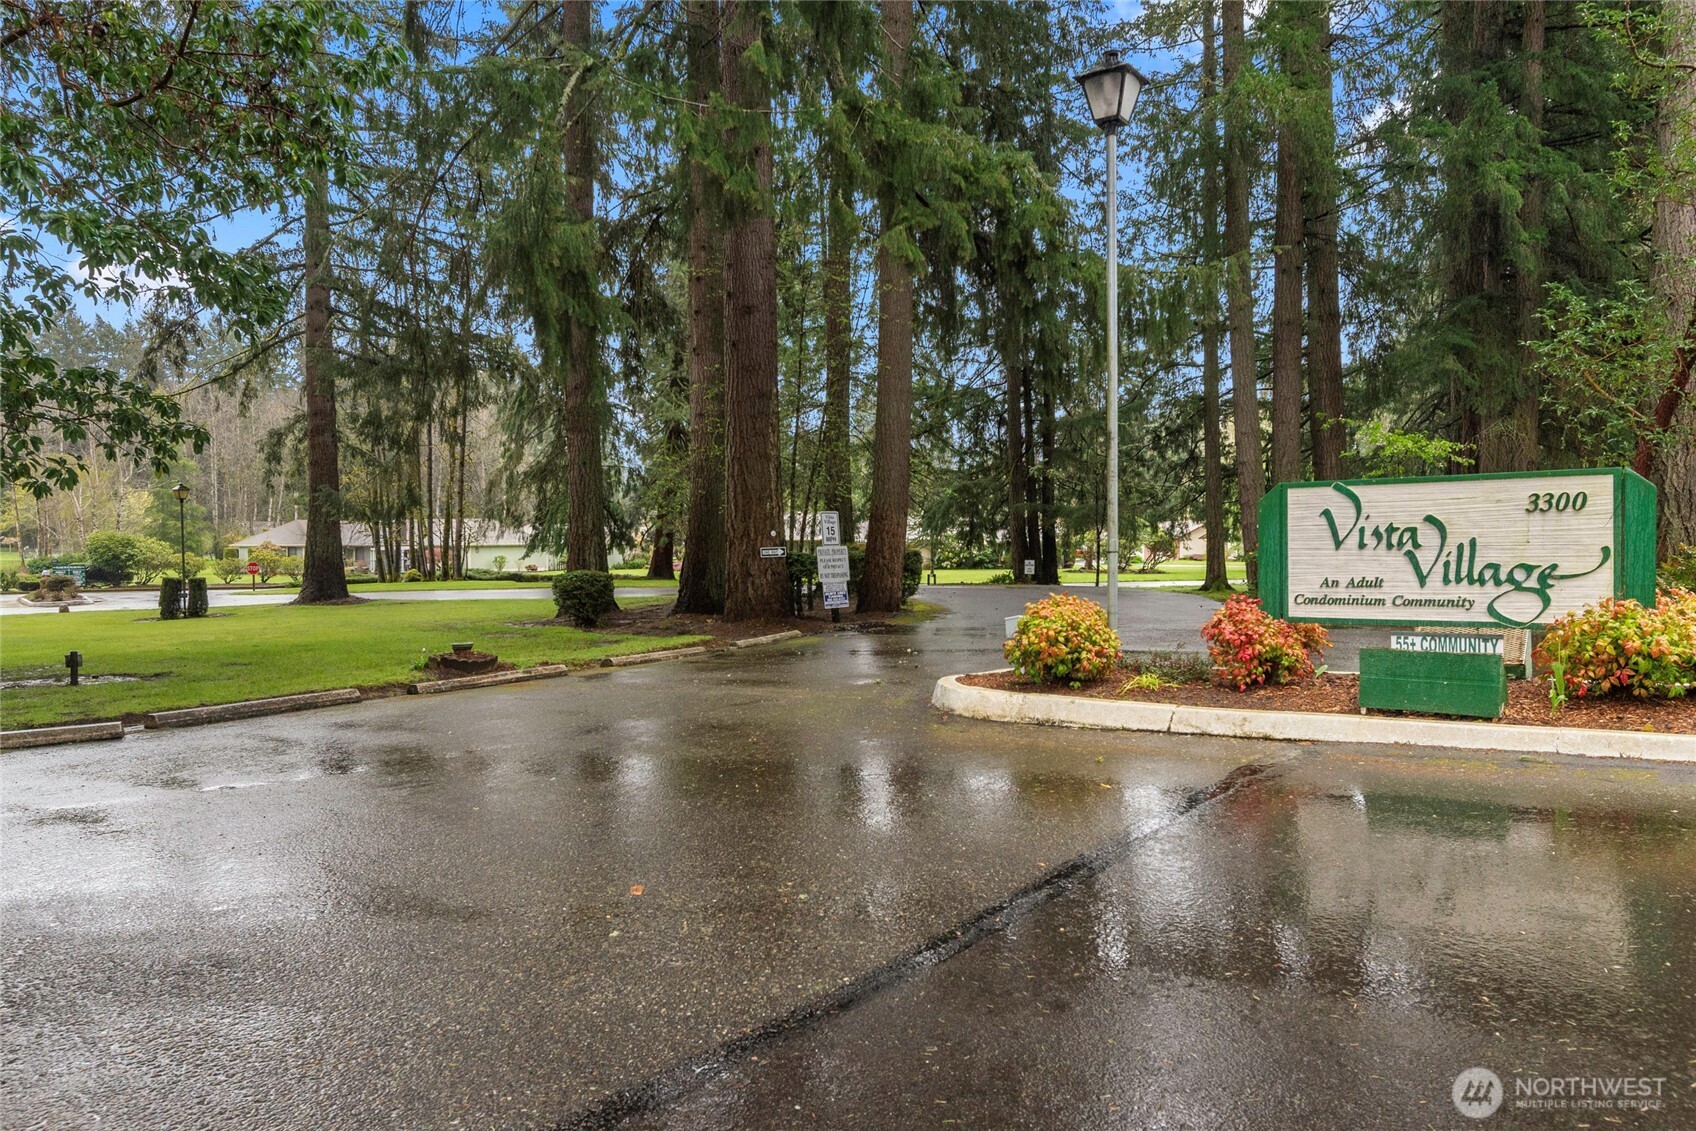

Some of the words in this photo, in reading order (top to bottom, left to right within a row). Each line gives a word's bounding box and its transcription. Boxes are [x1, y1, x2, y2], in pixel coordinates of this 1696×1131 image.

[1525, 491, 1588, 512] 3300
[1319, 482, 1422, 551] Vista
[826, 526, 836, 536] 15
[1404, 514, 1611, 628] Village
[1320, 577, 1340, 588] An
[1345, 577, 1384, 589] Adult
[1294, 594, 1386, 607] Condominium
[1392, 596, 1475, 611] Community
[1395, 636, 1416, 650] 55+
[1420, 636, 1499, 653] COMMUNITY
